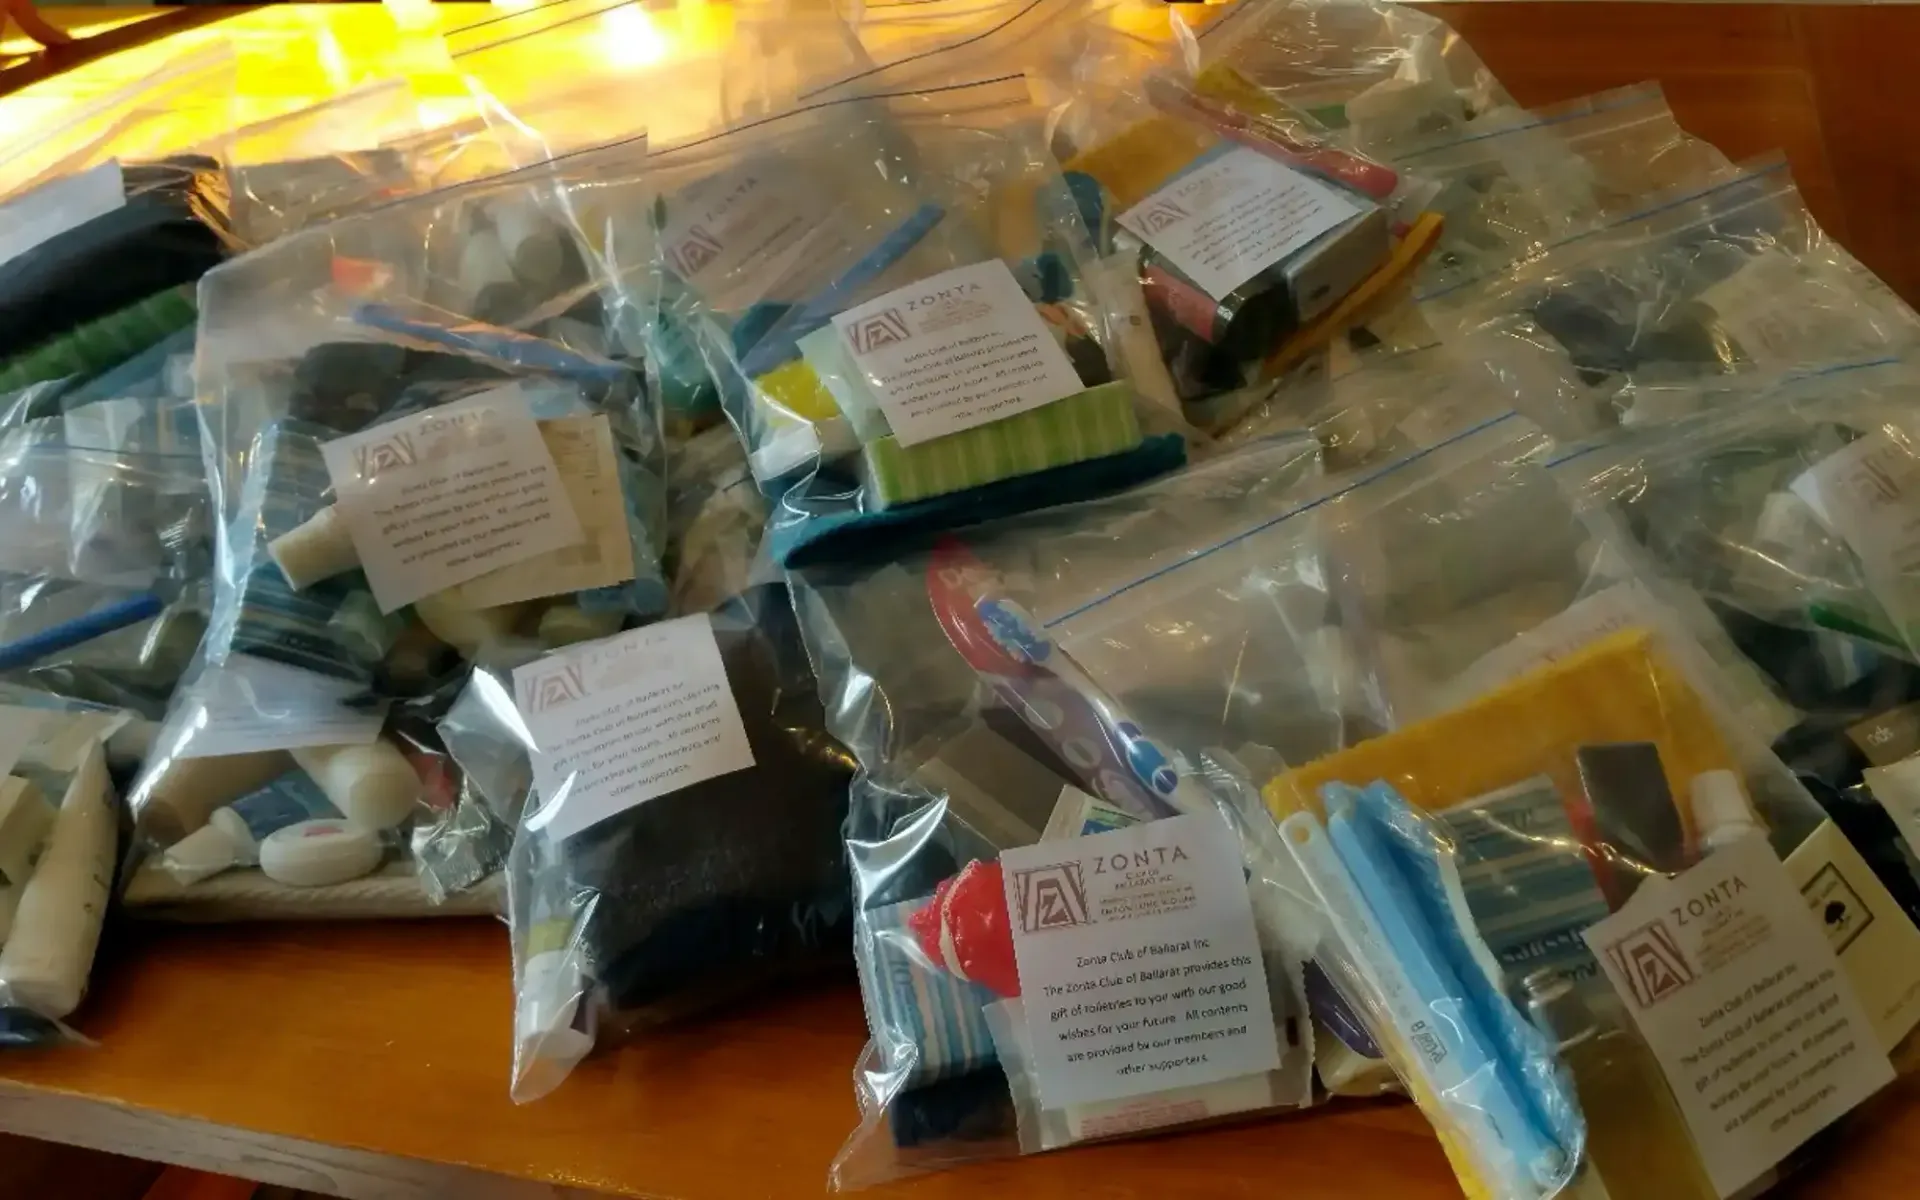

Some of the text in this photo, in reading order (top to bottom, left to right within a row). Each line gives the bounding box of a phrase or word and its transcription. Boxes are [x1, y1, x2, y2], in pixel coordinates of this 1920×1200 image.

[907, 283, 981, 311] ZONTA
[1094, 845, 1188, 874] ZONTA
[1671, 876, 1747, 925] ZONTA
[1076, 955, 1107, 968] Zonta
[1110, 948, 1134, 963] Club
[1136, 945, 1147, 958] of
[1149, 940, 1191, 955] Ballarat
[1043, 955, 1251, 996] The Zonta Club of Ballarat provides this
[1050, 978, 1246, 1022] gift of toiletries to you with our good
[1058, 1027, 1096, 1040] wishes
[1097, 1024, 1112, 1034] for
[1115, 1021, 1140, 1033] your
[1185, 1009, 1199, 1020] All
[1201, 1004, 1248, 1018] contents
[1067, 1025, 1247, 1062] are provided by our members and
[1116, 1063, 1146, 1075] other
